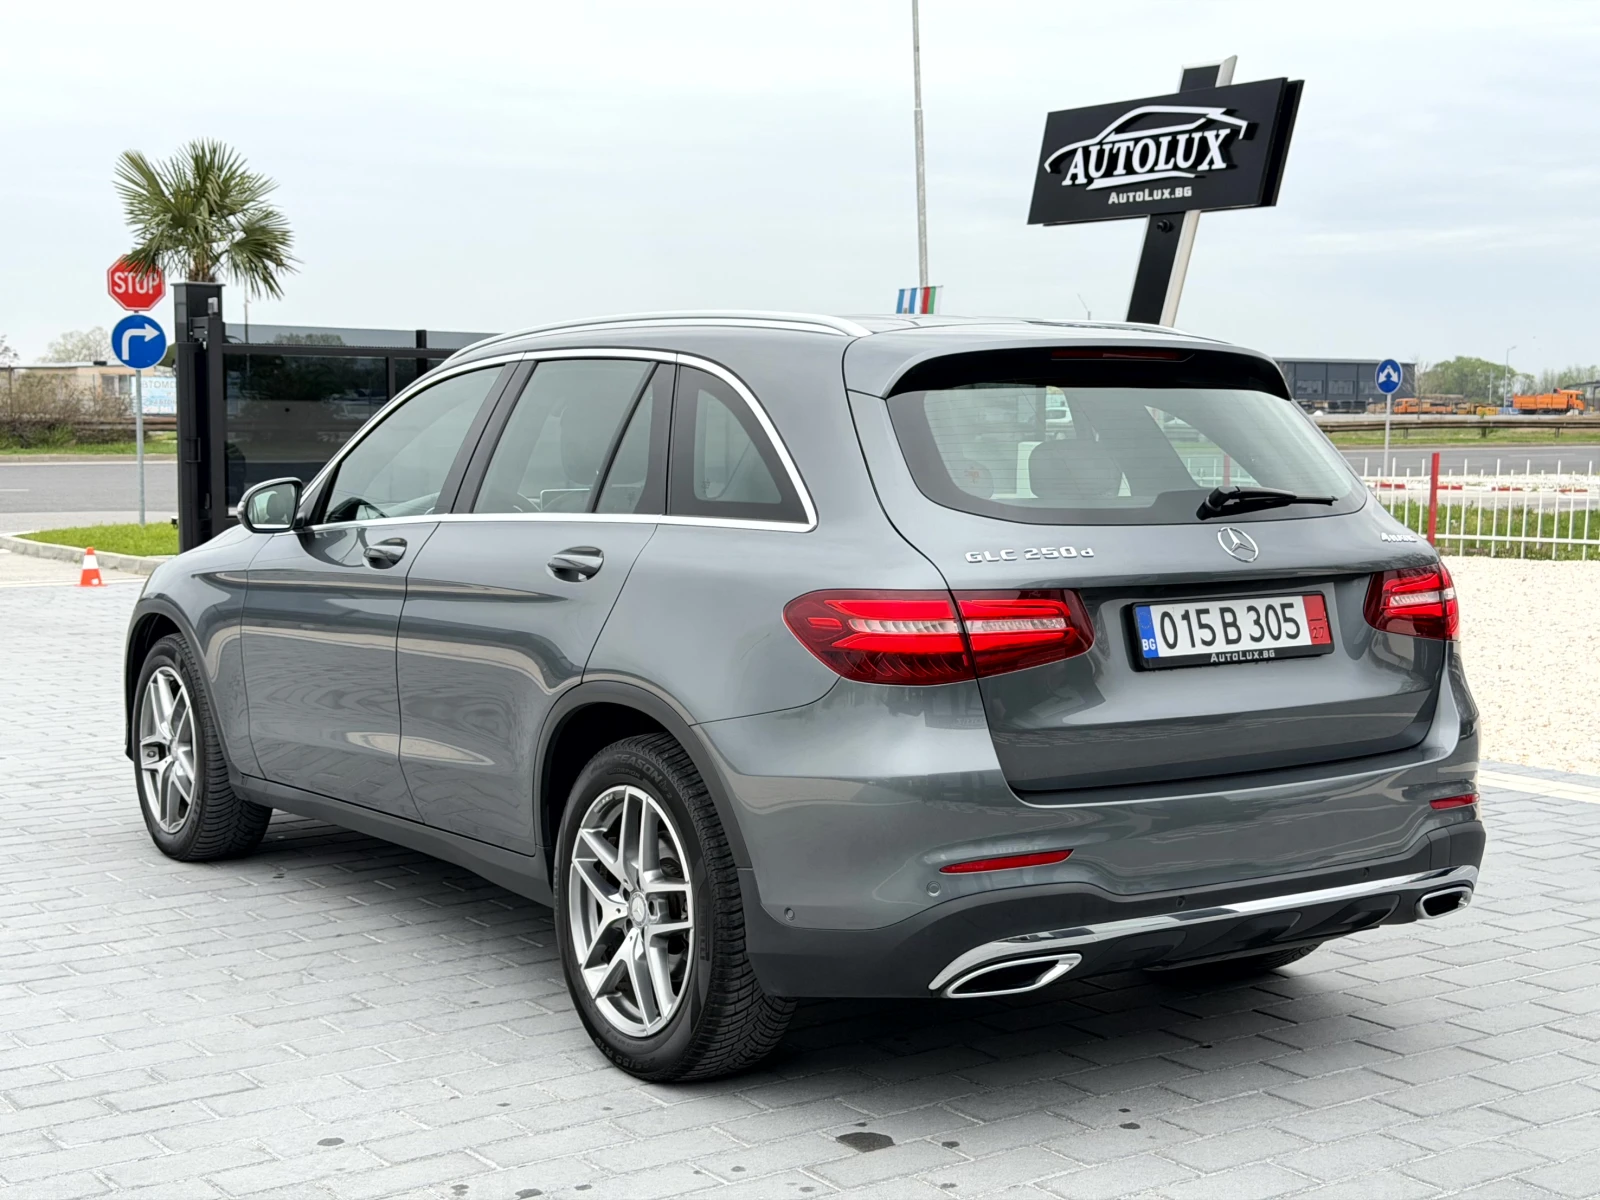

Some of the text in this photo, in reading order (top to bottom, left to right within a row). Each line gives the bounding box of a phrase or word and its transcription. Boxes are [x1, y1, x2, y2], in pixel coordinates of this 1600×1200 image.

[1062, 128, 1231, 185] AUTOLUX
[113, 271, 160, 294] STOP
[965, 549, 1018, 563] GLC
[1311, 626, 1325, 640] 27
[1142, 638, 1156, 651] BG
